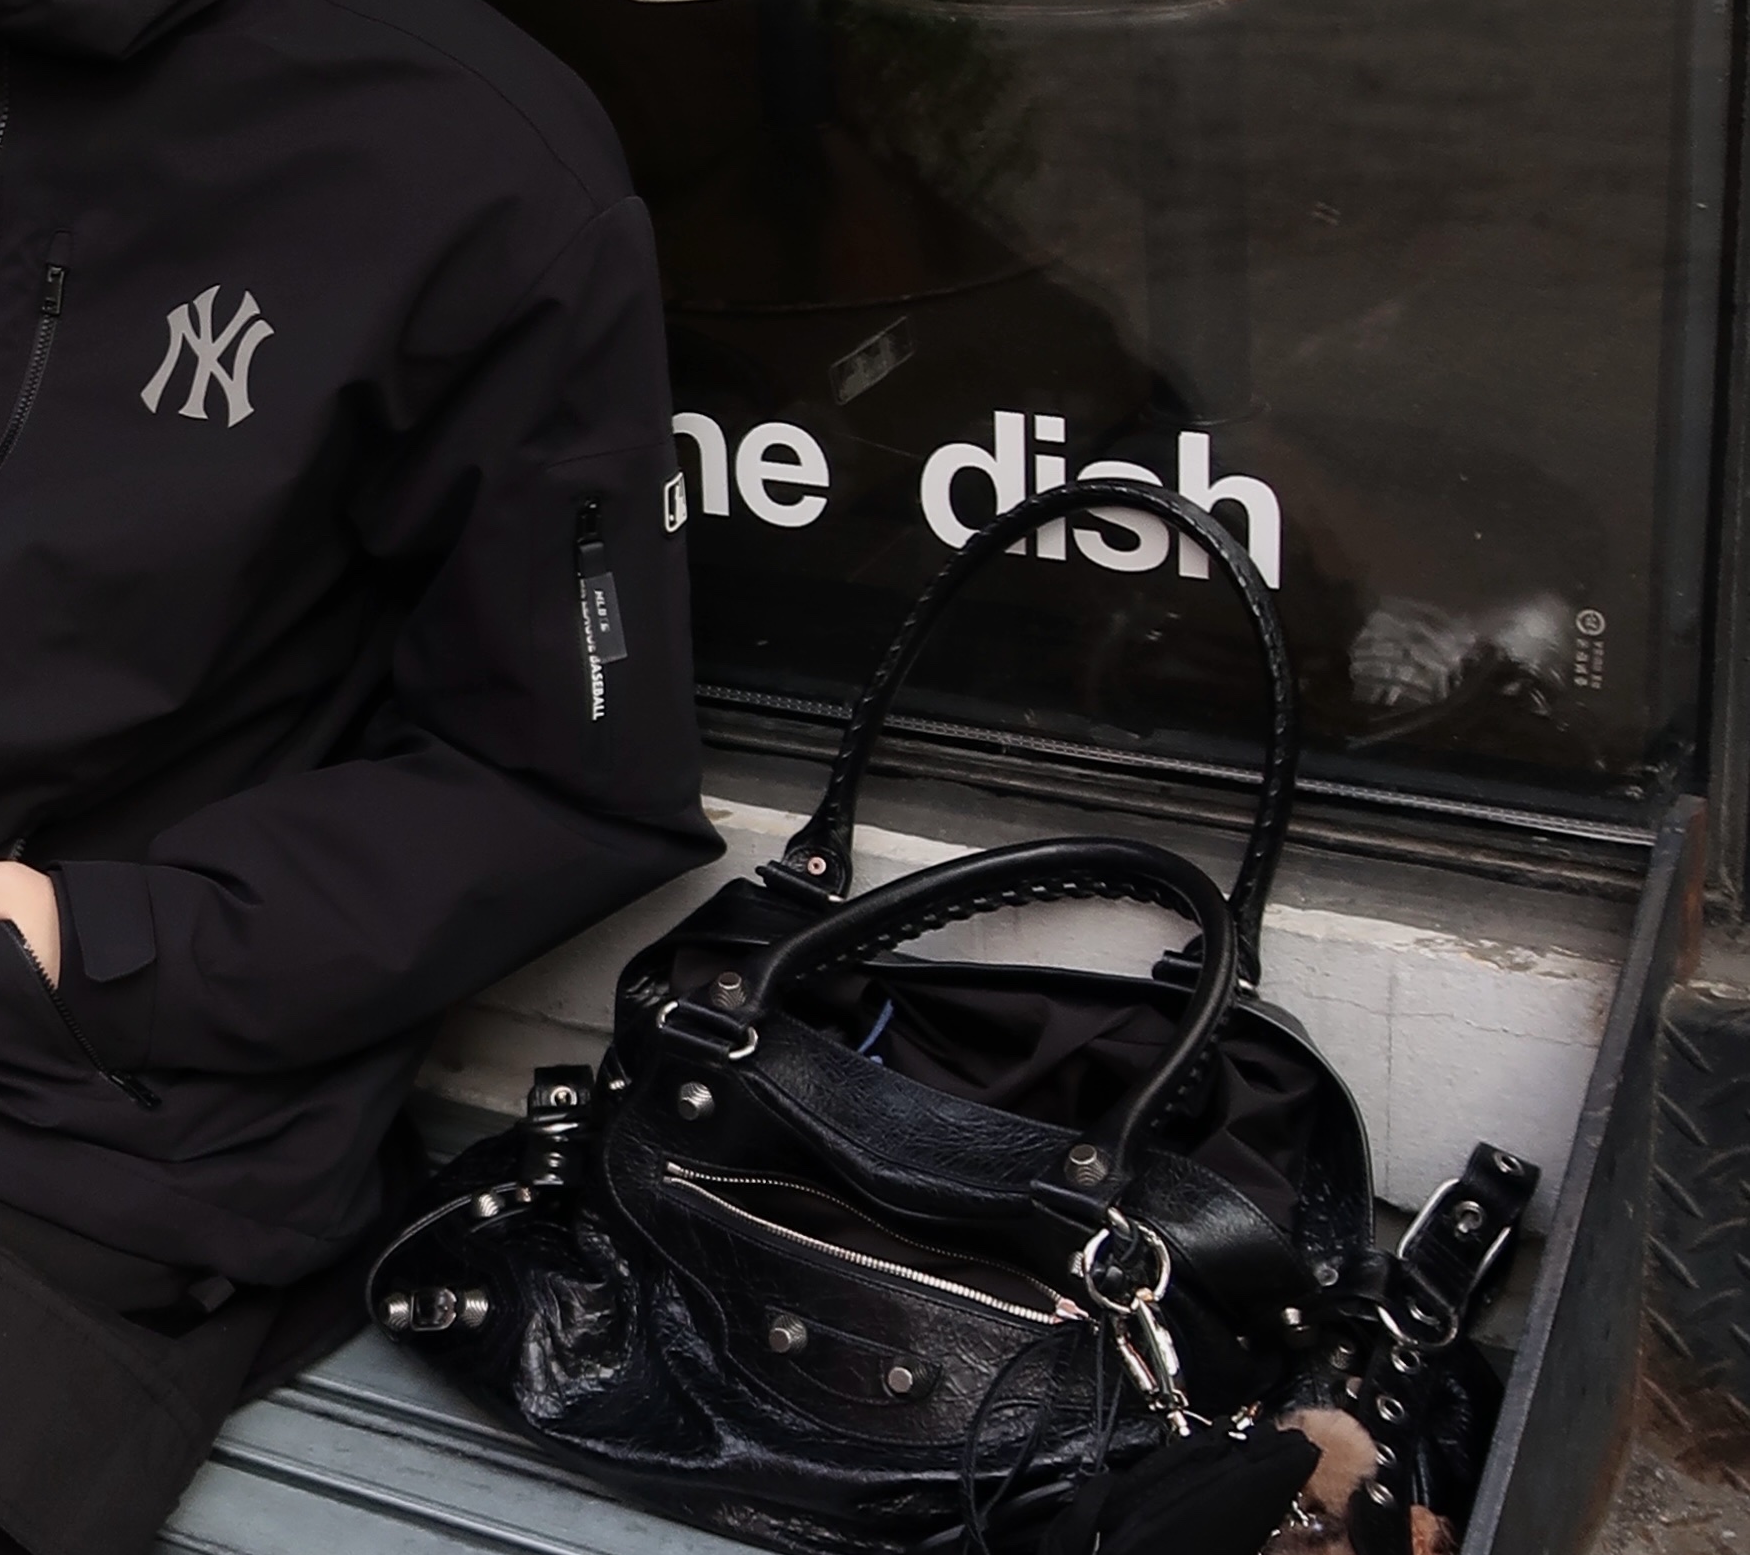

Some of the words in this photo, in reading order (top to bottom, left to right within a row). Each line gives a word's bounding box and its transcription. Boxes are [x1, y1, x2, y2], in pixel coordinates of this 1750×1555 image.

[140, 282, 277, 429] NY
[919, 406, 1281, 590] dish
[589, 656, 605, 720] BASEBALL
